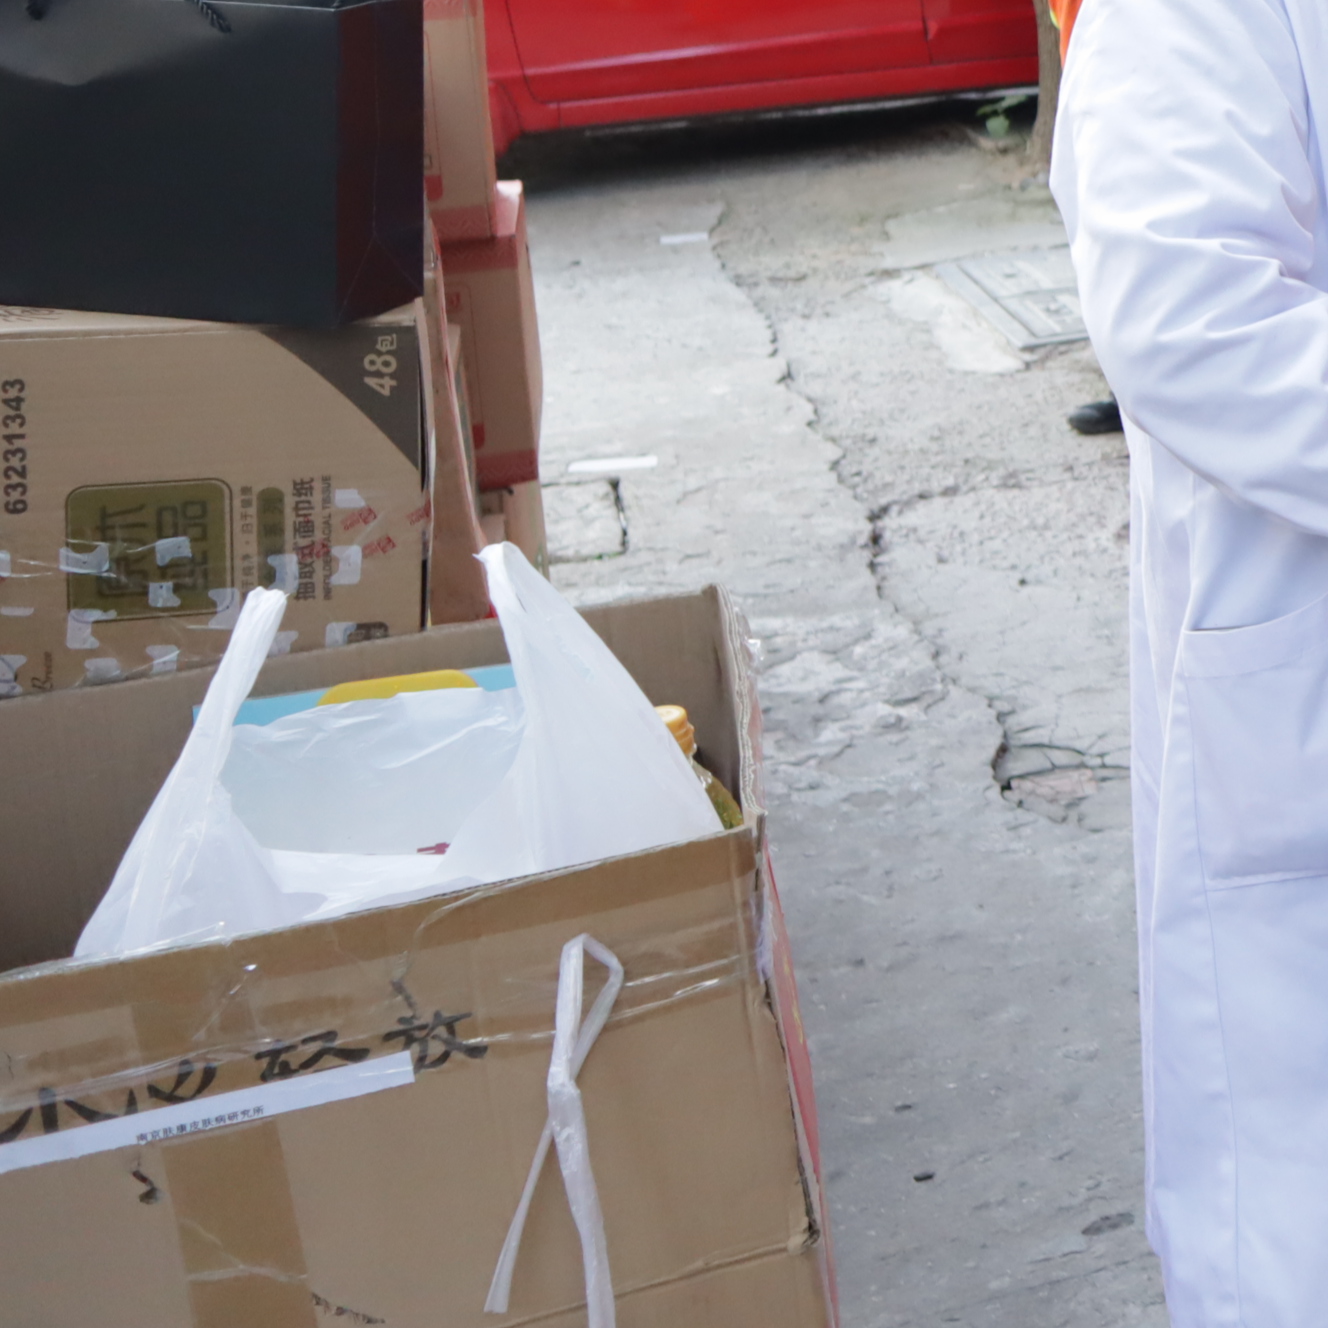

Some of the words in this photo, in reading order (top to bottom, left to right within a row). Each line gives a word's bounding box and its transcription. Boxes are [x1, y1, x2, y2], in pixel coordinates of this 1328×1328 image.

[1, 378, 28, 515] 63231343
[136, 1105, 265, 1144] 南京肤康皮肤病研究所
